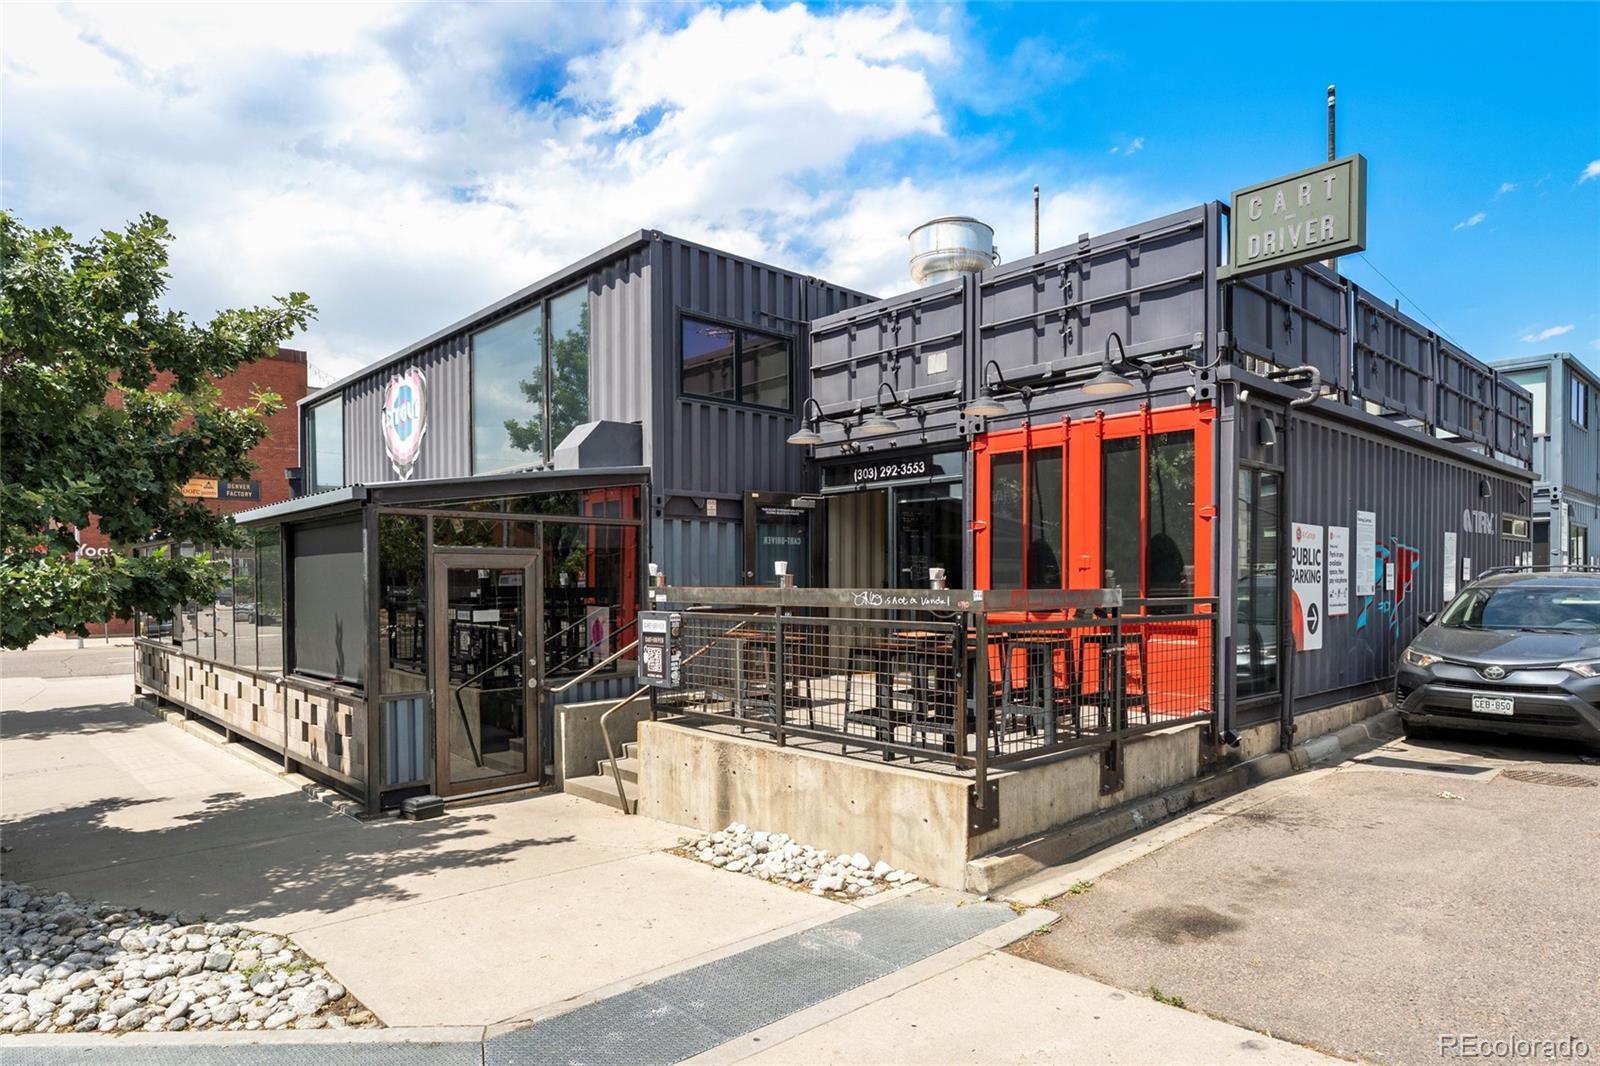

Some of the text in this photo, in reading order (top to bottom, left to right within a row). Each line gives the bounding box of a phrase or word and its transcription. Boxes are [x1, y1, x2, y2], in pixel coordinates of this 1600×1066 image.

[1249, 173, 1336, 221] CART
[1248, 214, 1335, 259] DRIVER
[854, 461, 925, 482] (303) 292-3553
[1291, 547, 1321, 567] PUBLIC
